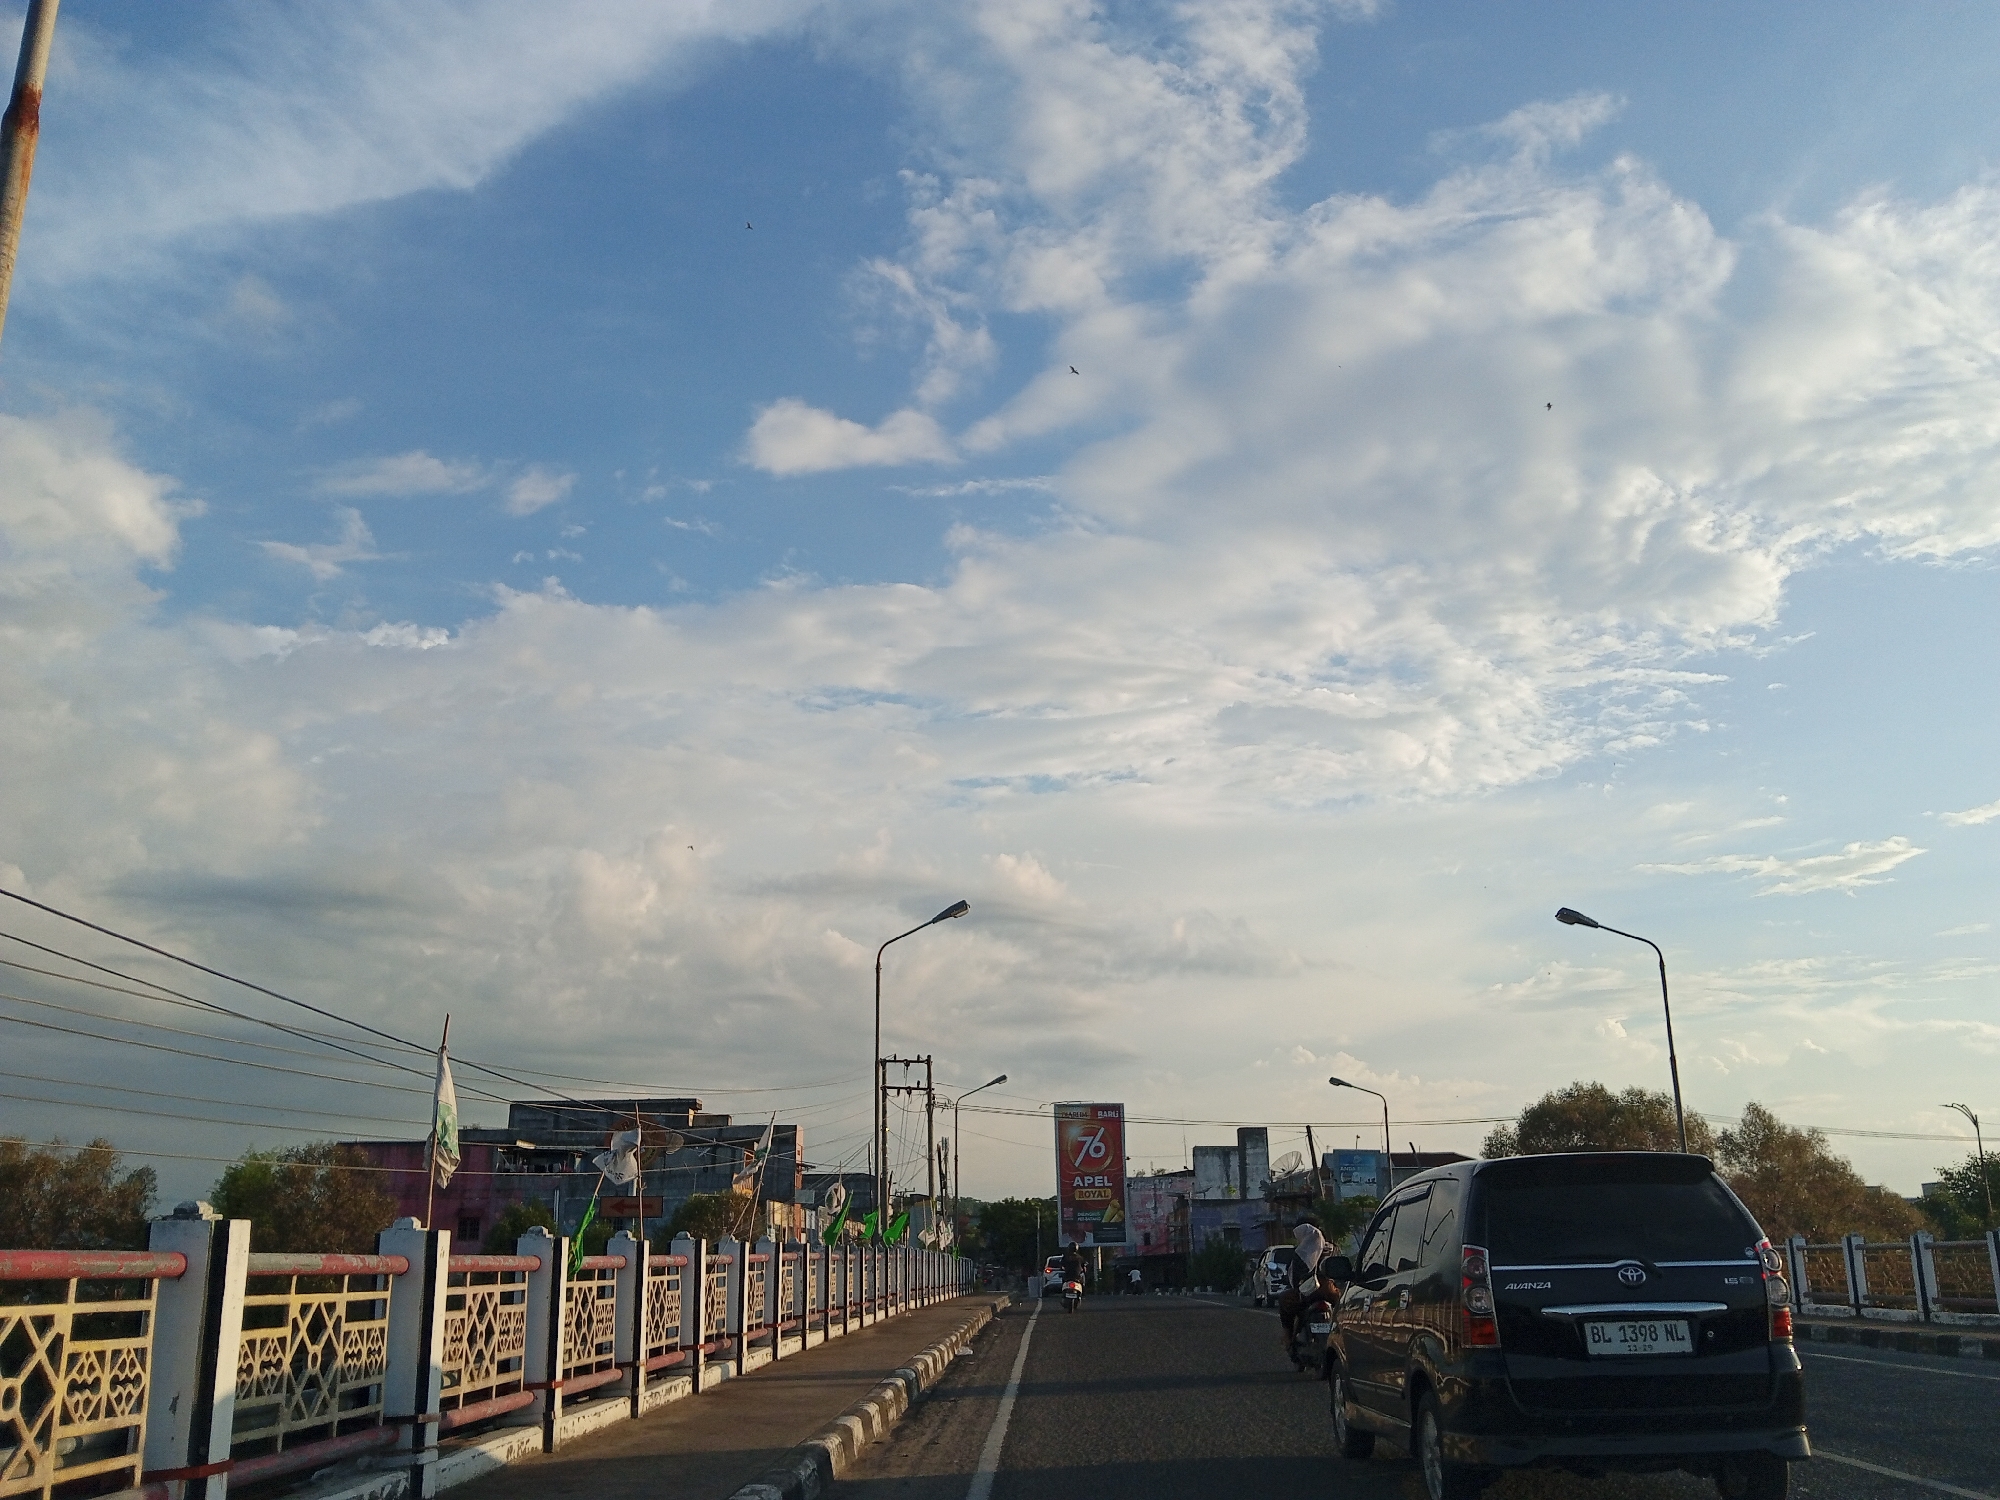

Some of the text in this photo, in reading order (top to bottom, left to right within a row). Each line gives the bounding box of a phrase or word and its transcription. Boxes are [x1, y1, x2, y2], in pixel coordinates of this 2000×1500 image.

[1097, 1110, 1119, 1118] BARU
[1074, 1126, 1106, 1168] 76
[1072, 1175, 1113, 1187] APEL
[1078, 1189, 1109, 1199] ROYAL
[1504, 1281, 1552, 1290] AVANZA
[1590, 1322, 1686, 1344] BL 1398 NL
